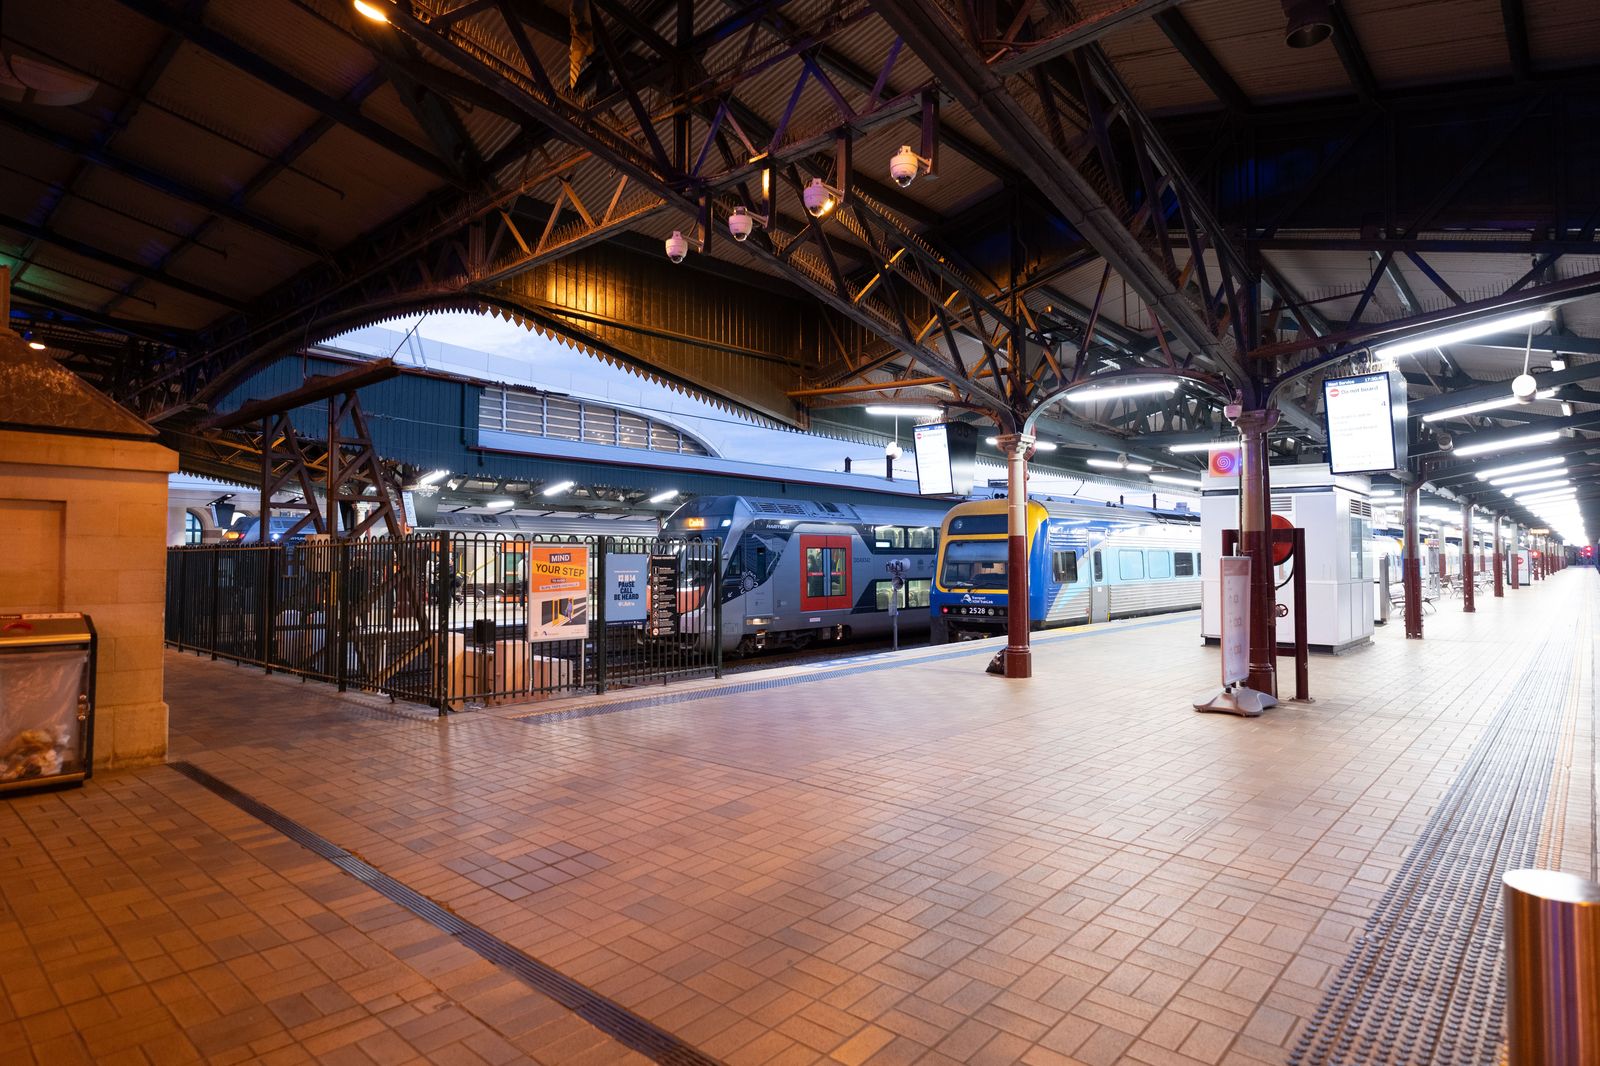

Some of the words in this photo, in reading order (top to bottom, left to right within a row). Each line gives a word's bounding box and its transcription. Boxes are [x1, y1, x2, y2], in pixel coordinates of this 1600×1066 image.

[1361, 385, 1379, 393] board
[551, 554, 570, 562] MIND
[536, 563, 560, 574] YOUR
[562, 566, 584, 577] STEP
